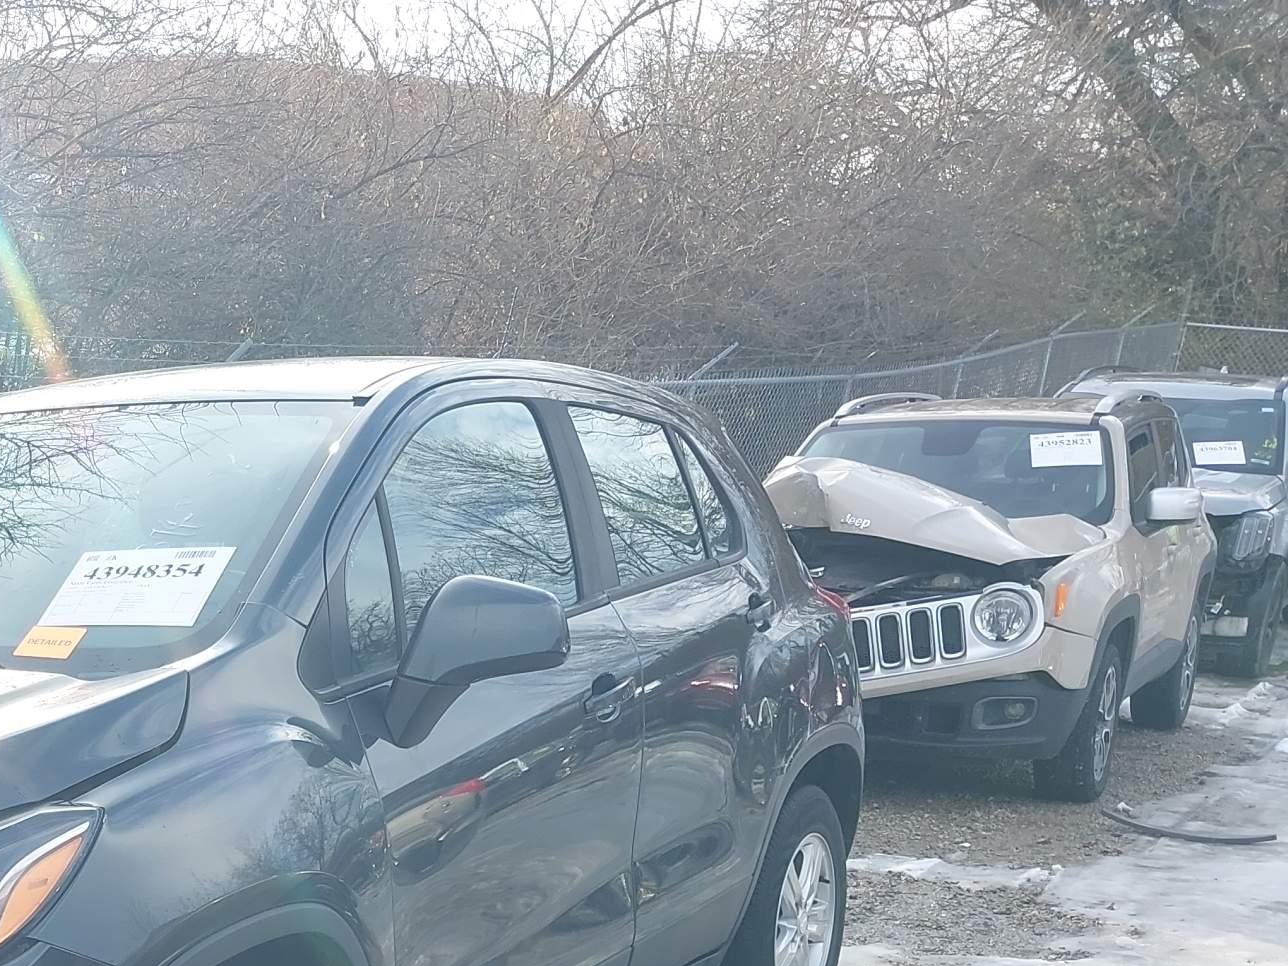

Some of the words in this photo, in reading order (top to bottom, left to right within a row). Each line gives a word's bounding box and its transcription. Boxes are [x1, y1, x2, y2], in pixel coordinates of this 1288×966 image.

[840, 513, 871, 529] Jeep
[83, 563, 206, 581] 43948354
[27, 638, 72, 647] DETAILED
